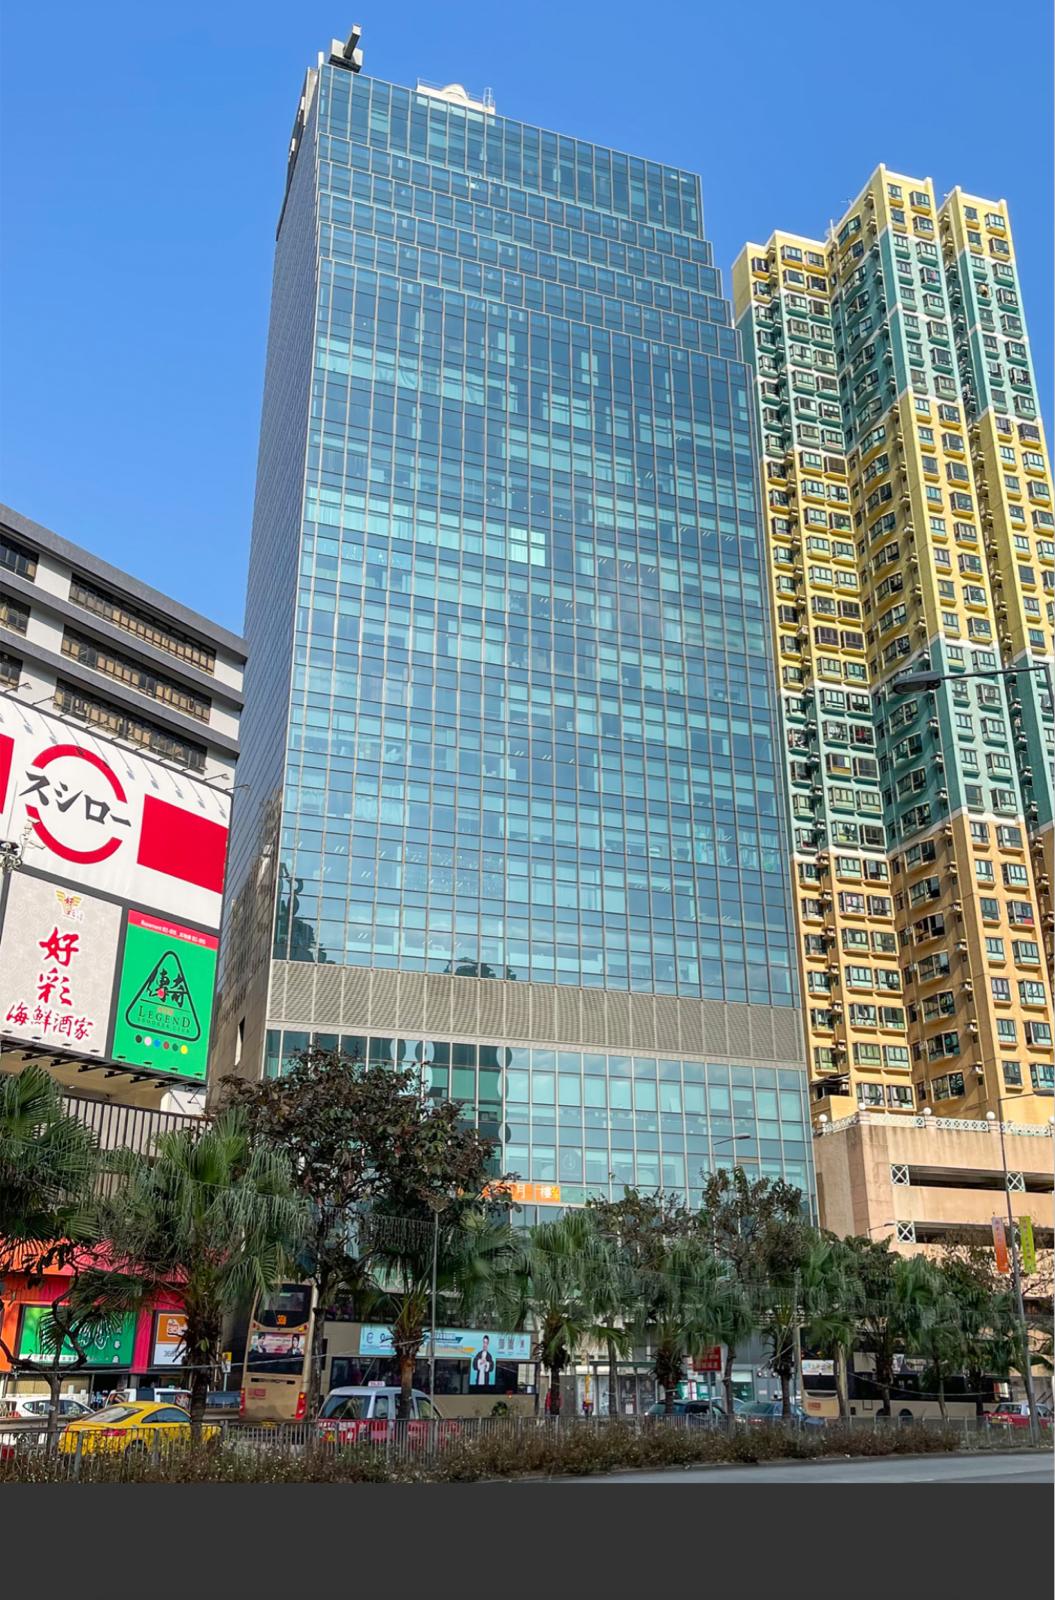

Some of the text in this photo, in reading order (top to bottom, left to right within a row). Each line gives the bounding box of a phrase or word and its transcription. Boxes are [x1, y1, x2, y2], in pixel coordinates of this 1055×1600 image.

[19, 771, 132, 828] スシロー
[6, 1002, 94, 1040] 海鮮酒家
